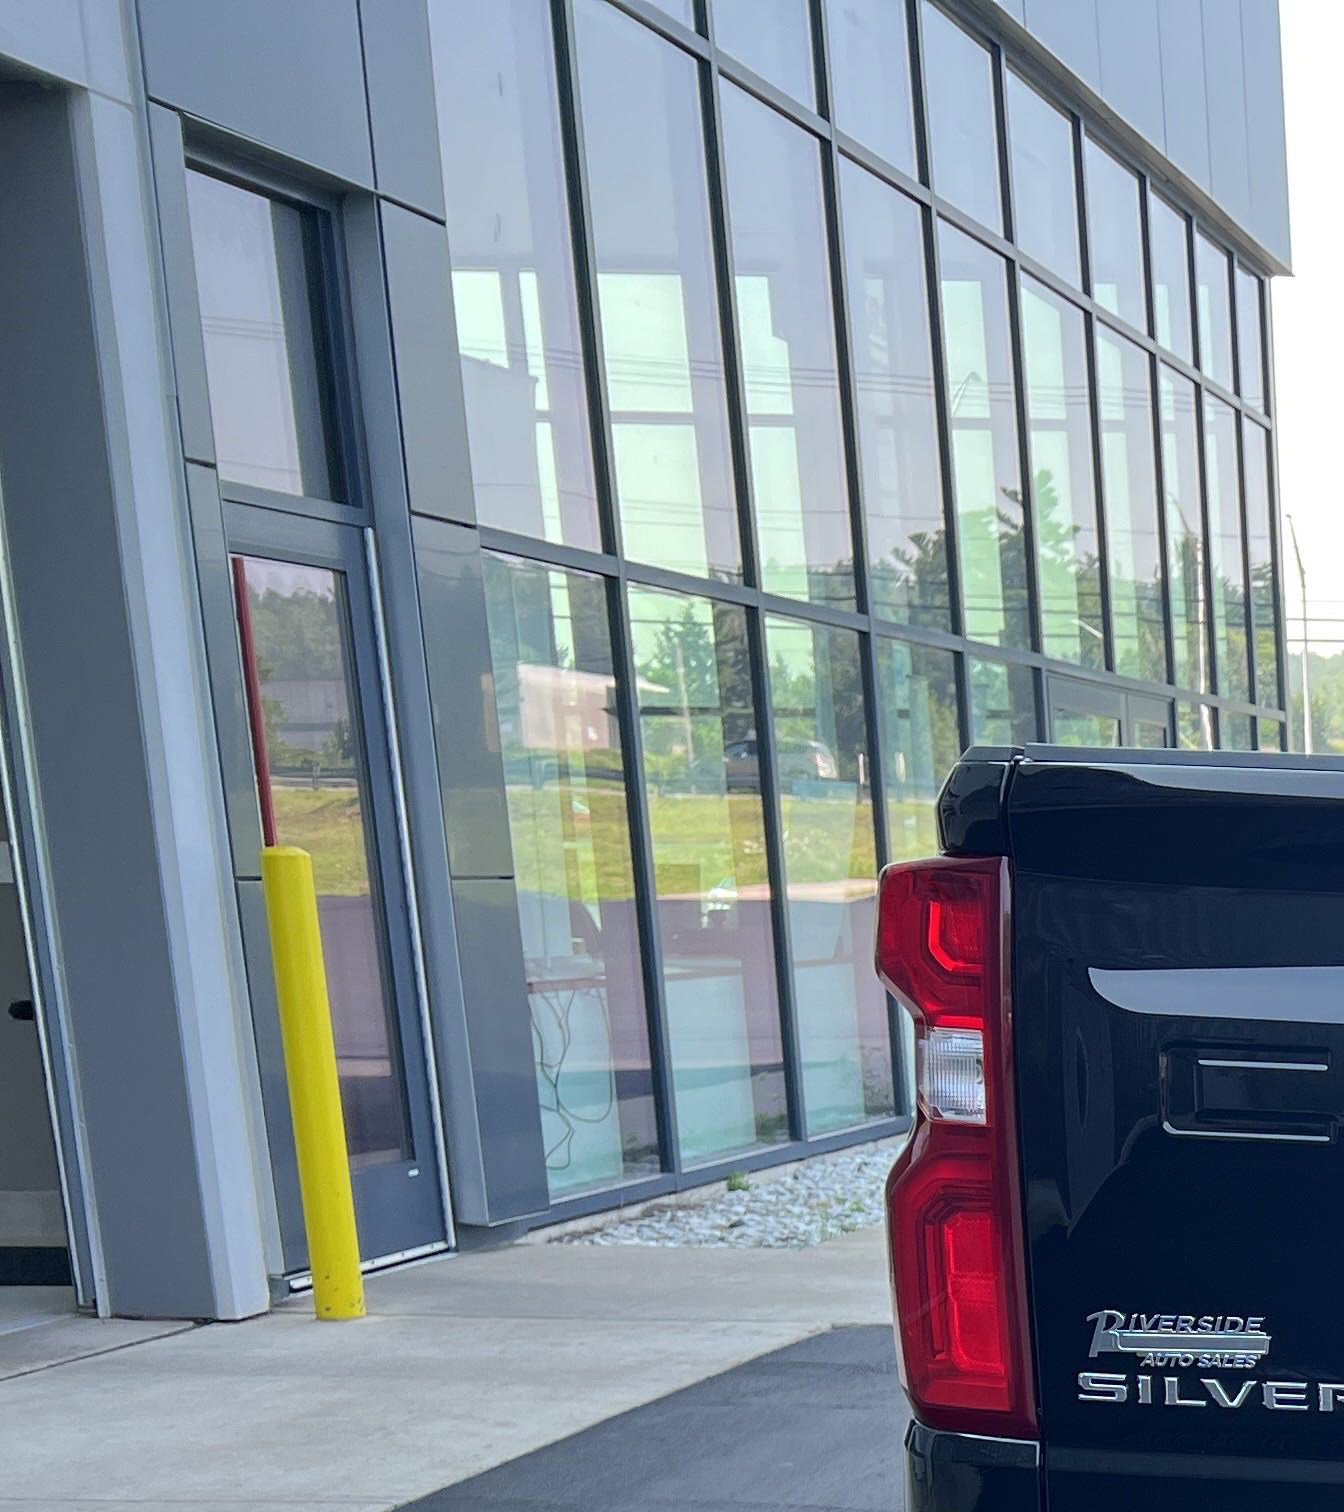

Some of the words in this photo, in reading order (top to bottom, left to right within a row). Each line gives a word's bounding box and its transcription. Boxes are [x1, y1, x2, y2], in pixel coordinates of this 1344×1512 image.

[1086, 1309, 1267, 1358] RIVERSIDE
[1139, 1352, 1194, 1368] AUTO
[1196, 1353, 1258, 1369] SALES
